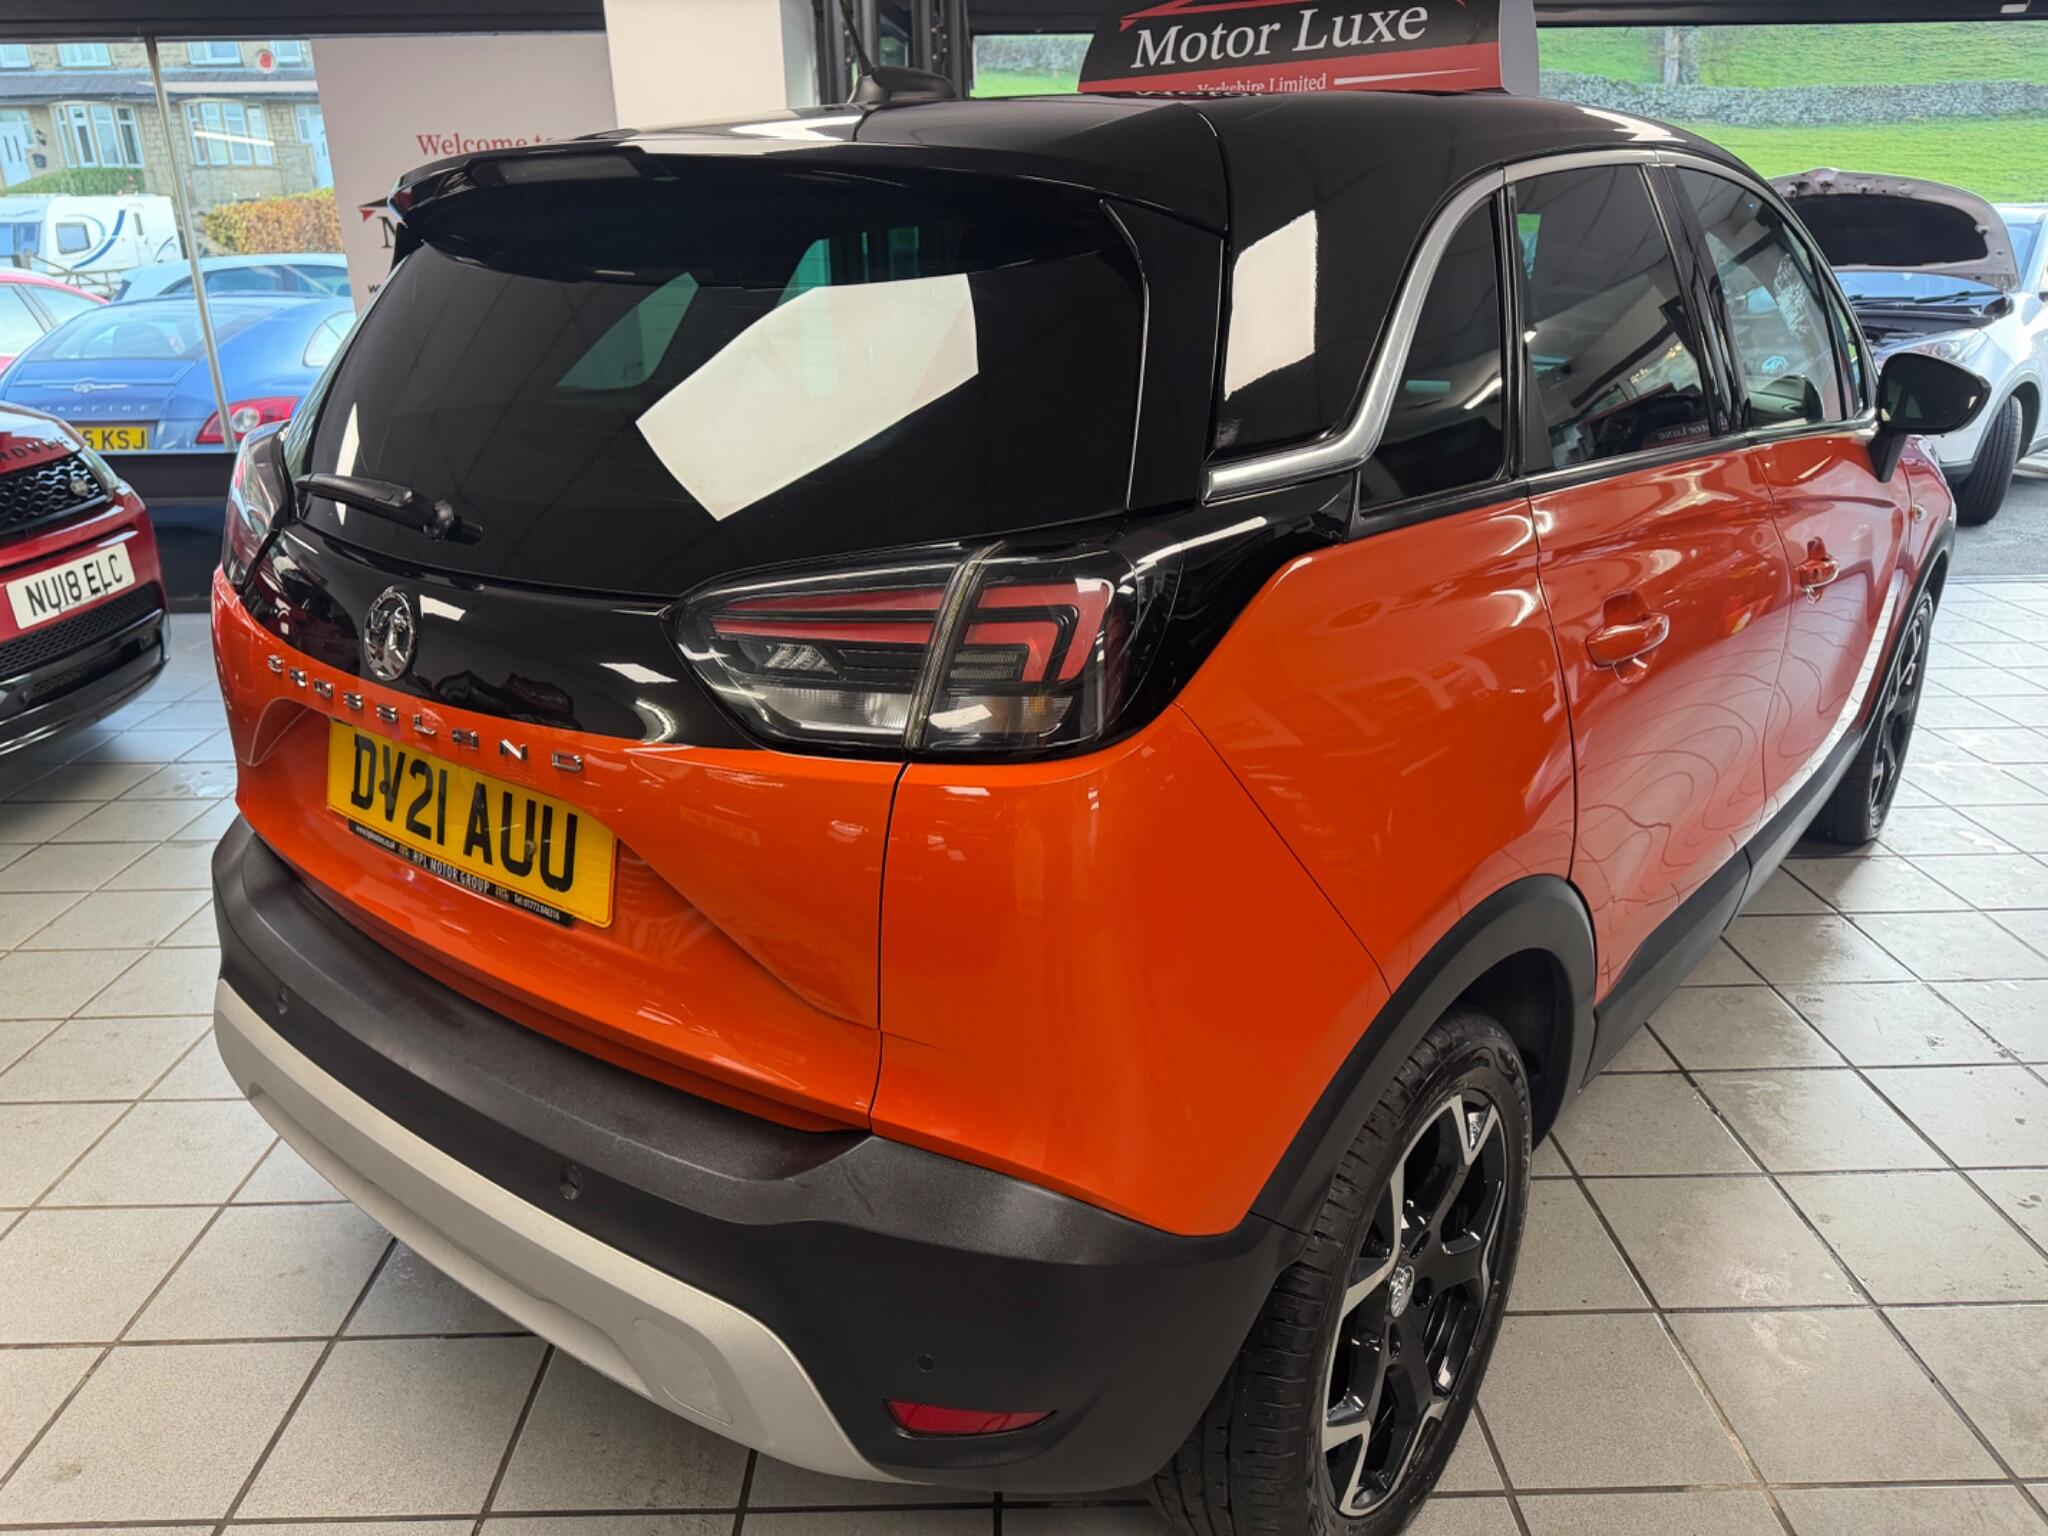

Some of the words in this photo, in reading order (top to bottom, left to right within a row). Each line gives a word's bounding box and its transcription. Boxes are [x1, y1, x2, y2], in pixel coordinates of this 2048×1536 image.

[1131, 20, 1280, 68] Motor
[1292, 6, 1428, 52] Luxe
[1269, 72, 1327, 93] Limited
[416, 133, 527, 156] Welcome
[101, 429, 146, 450] KSJ
[25, 568, 82, 617] NU18
[83, 553, 123, 597] ELC
[351, 733, 448, 847] DV21
[463, 782, 578, 894] AUU
[429, 858, 458, 881] MOTOR
[459, 871, 490, 894] GROUP
